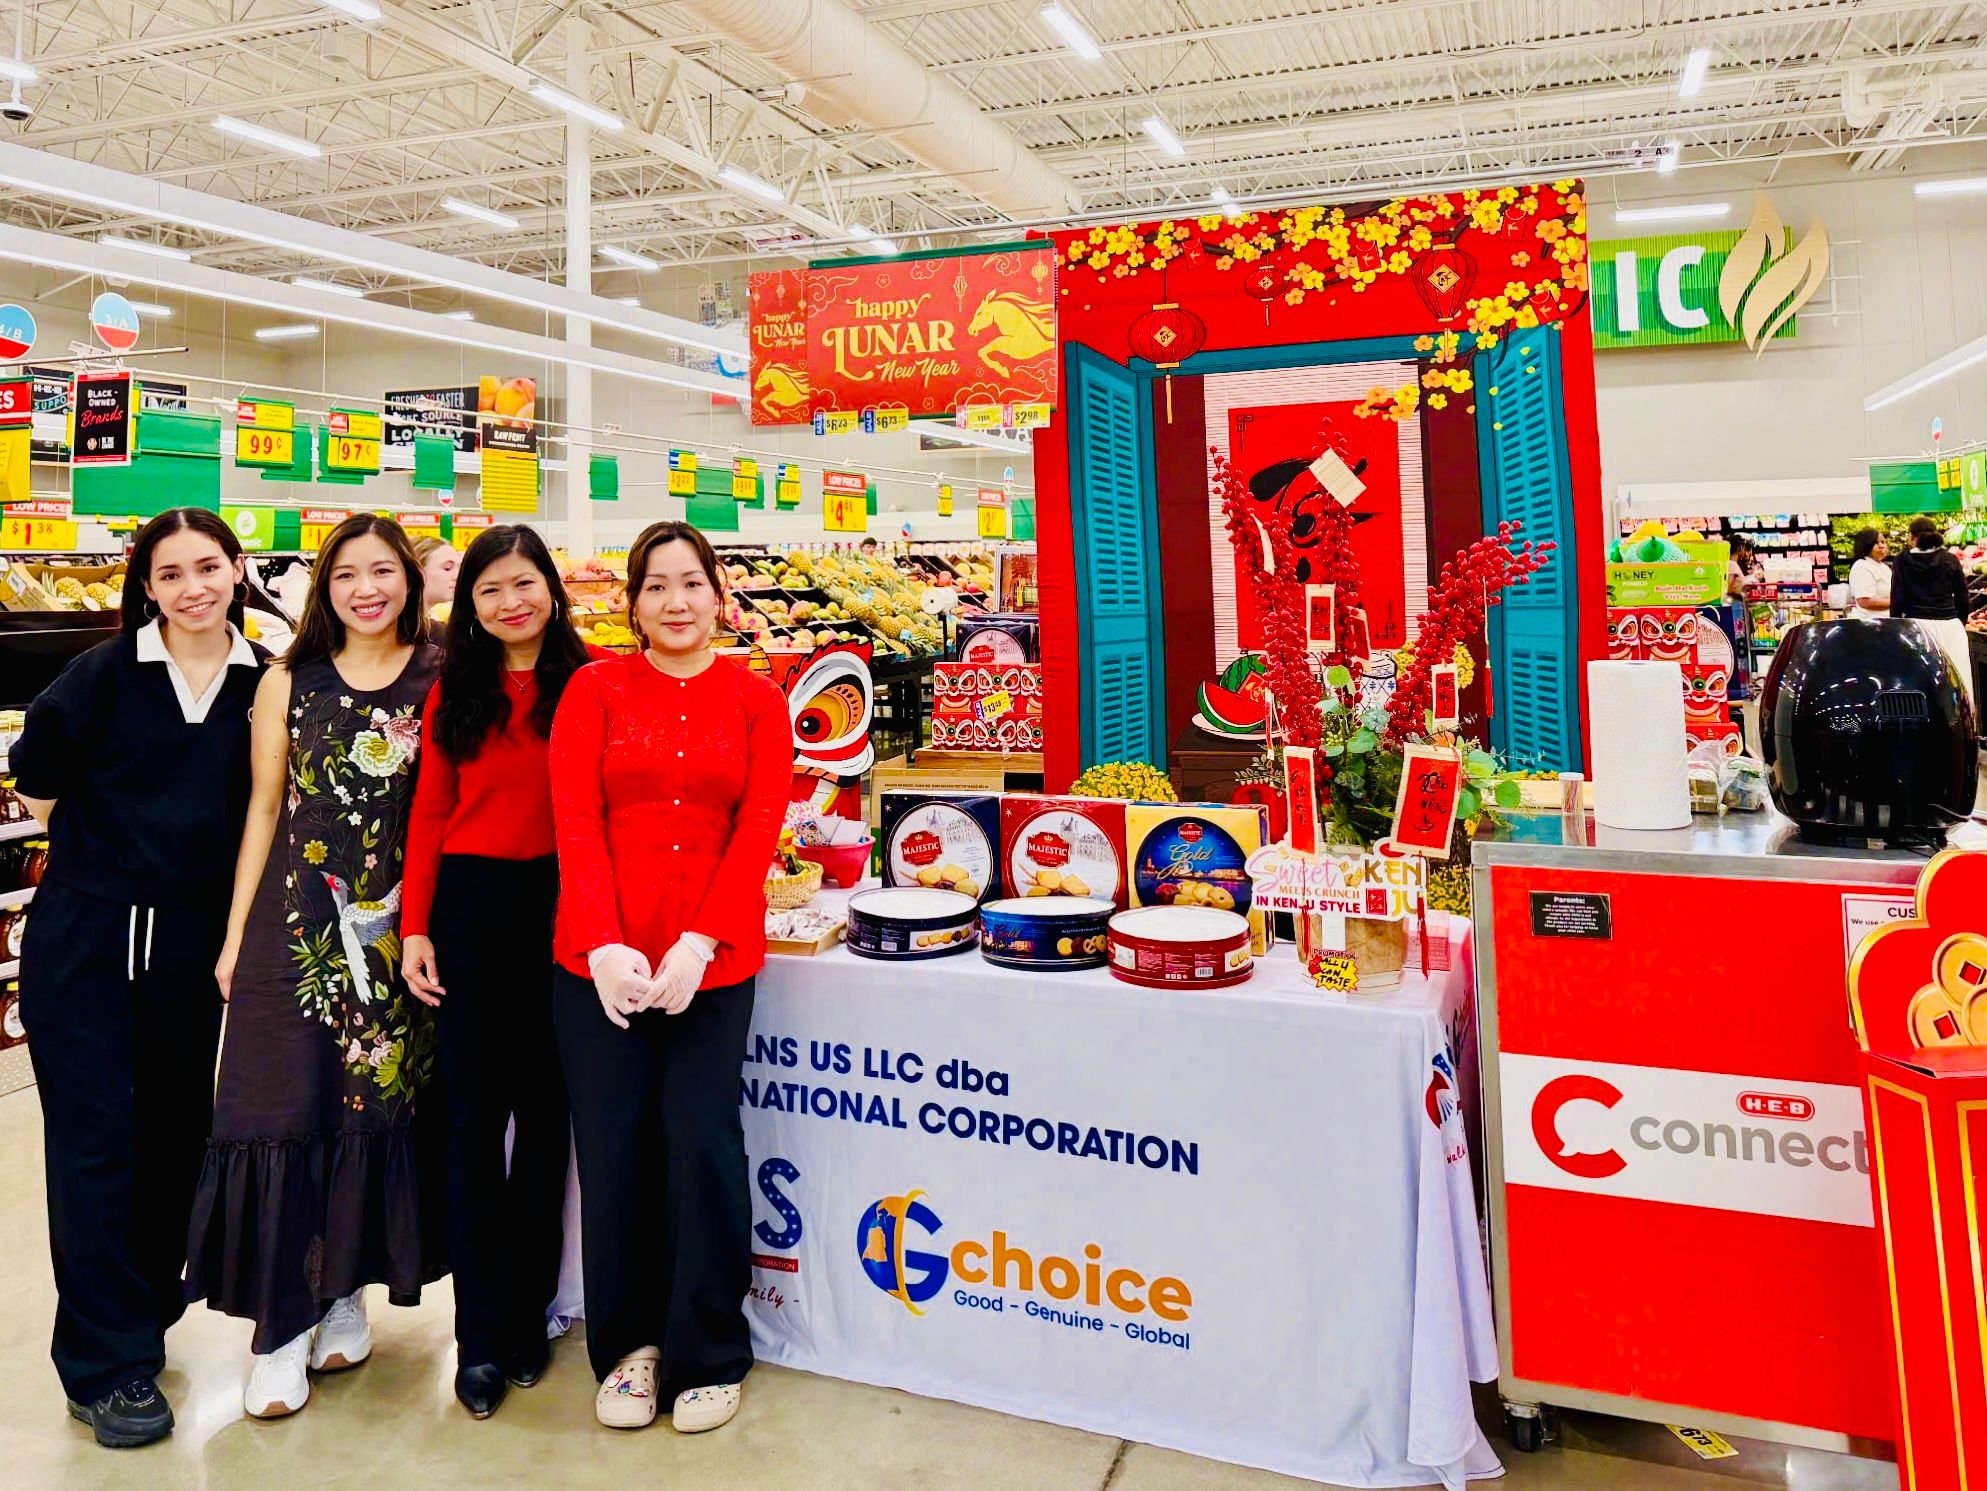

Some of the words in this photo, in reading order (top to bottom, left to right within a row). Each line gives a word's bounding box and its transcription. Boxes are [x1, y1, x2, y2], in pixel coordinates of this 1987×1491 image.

[847, 293, 931, 320] happy
[761, 312, 796, 324] happy
[753, 322, 804, 348] LUNAR
[822, 320, 955, 381] LUNAR
[876, 359, 916, 381] New
[916, 358, 960, 388] Year
[88, 398, 116, 407] OWNED
[391, 394, 426, 411] FRESH
[81, 404, 123, 427] Brands
[877, 416, 897, 429] $673
[13, 503, 36, 511] LOW
[903, 841, 940, 856] MAJESTIC
[1028, 842, 1068, 857] MAJESTIC
[1169, 843, 1217, 862] Gold
[1251, 849, 1338, 893] Sweet
[1315, 887, 1361, 899] CRUNCH
[1553, 896, 1586, 904] Parents:
[1256, 896, 1269, 906] IN
[1319, 900, 1361, 914] STYLE
[1322, 957, 1339, 967] ALL
[1319, 975, 1351, 987] TASTE
[1320, 968, 1341, 977] CAN
[810, 1040, 851, 1075] US
[863, 1047, 924, 1084] LLC
[936, 1058, 1009, 1097] dba
[738, 1077, 907, 1129] NATIONAL
[918, 1102, 1199, 1176] CORPORATION
[1630, 1115, 1871, 1176] connect
[954, 1289, 1003, 1313] Good
[1025, 1300, 1104, 1331] Genuine
[1125, 1322, 1190, 1350] Global
